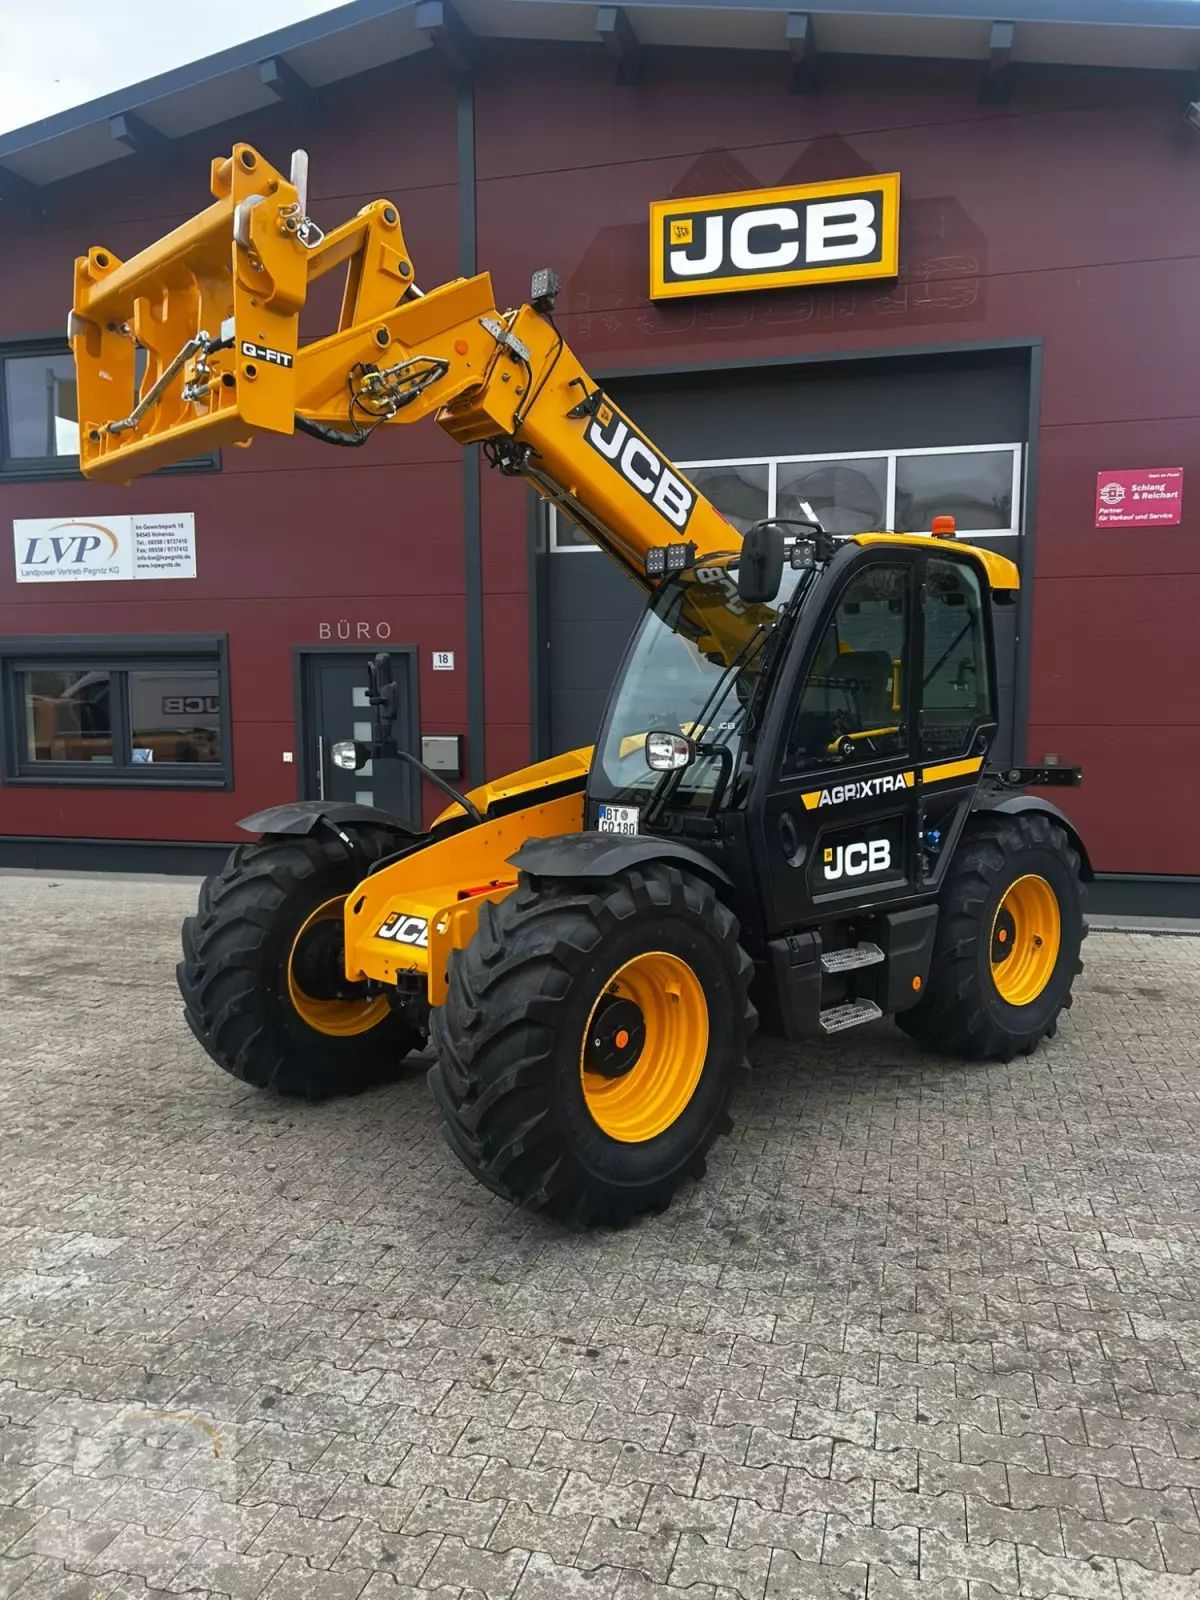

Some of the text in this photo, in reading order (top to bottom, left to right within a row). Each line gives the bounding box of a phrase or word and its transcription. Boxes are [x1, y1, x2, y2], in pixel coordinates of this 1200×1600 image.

[670, 199, 876, 275] JCB
[242, 342, 292, 367] Q-FIT
[590, 420, 692, 527] JCB
[1131, 484, 1166, 492] Schlang
[1141, 491, 1179, 500] Reichart
[21, 535, 102, 565] LVP
[22, 566, 120, 577] Landpower Vertrieb Pegnitz KG
[319, 619, 391, 639] BÜRO
[438, 654, 449, 664] 18
[606, 808, 620, 821] BT
[616, 822, 635, 836] 180
[824, 839, 891, 880] JCB
